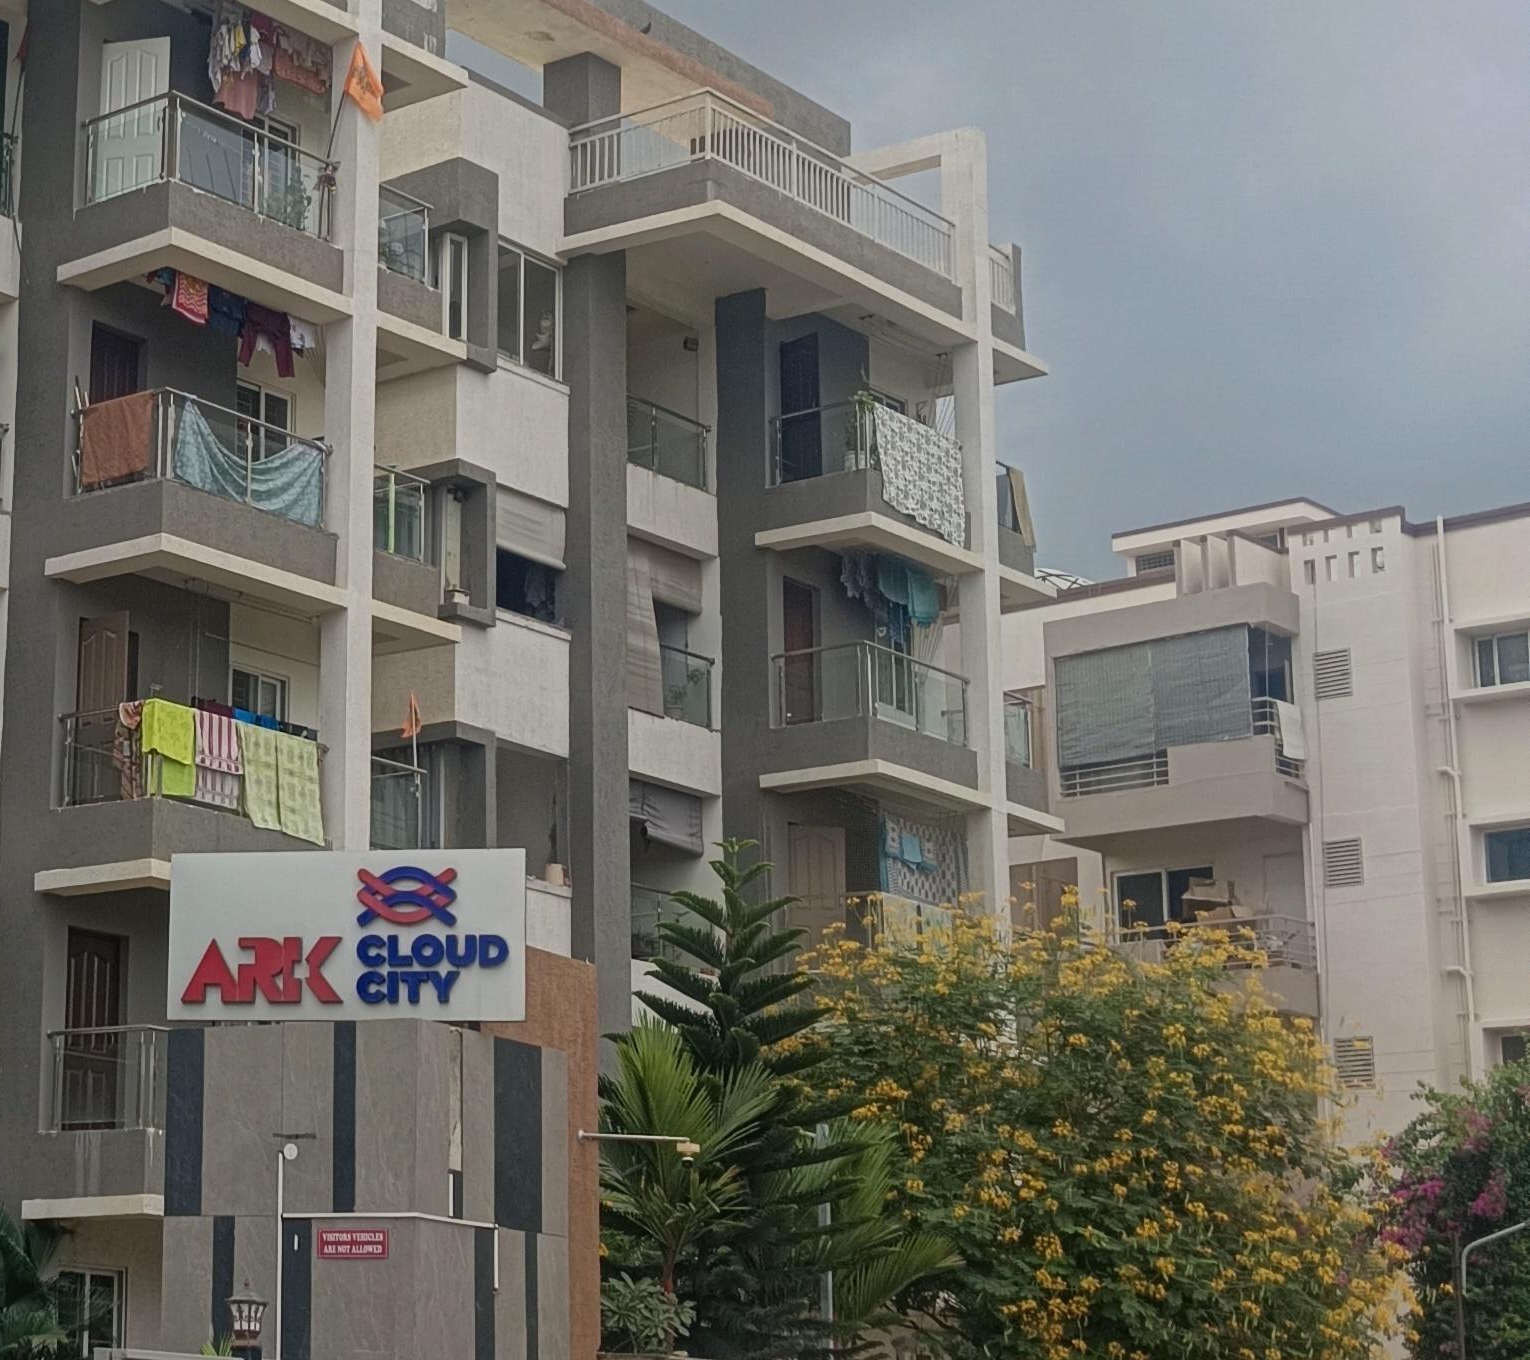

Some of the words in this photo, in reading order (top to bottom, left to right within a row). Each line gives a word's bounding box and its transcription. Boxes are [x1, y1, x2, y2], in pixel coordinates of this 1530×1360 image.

[356, 934, 510, 969] CLOUD
[180, 936, 344, 1004] ARK
[356, 970, 461, 1005] CITY
[322, 1232, 351, 1242] VISITORS
[352, 1232, 384, 1242] VEHICLES
[323, 1244, 337, 1254] ARE
[337, 1244, 350, 1254] NOT
[351, 1244, 383, 1254] ALLOWED
